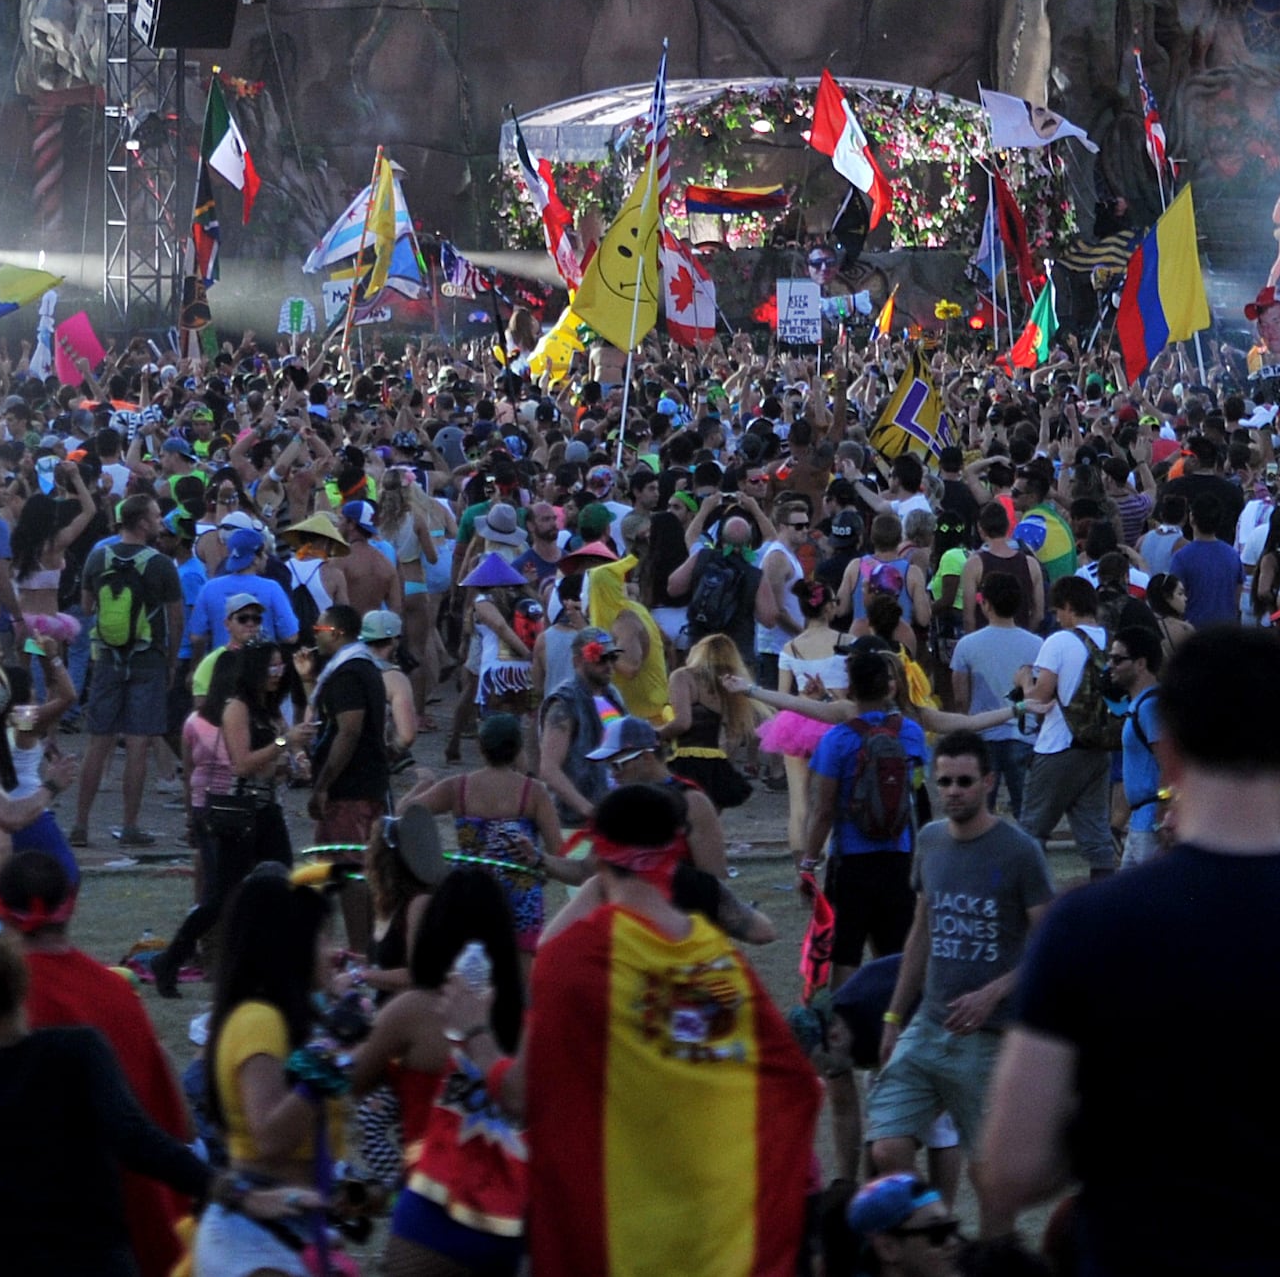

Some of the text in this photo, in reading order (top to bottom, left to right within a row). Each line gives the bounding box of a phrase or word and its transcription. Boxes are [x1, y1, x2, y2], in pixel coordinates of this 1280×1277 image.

[931, 891, 997, 918] JACK &
[931, 914, 998, 939] JONES
[931, 937, 999, 962] EST. 75
